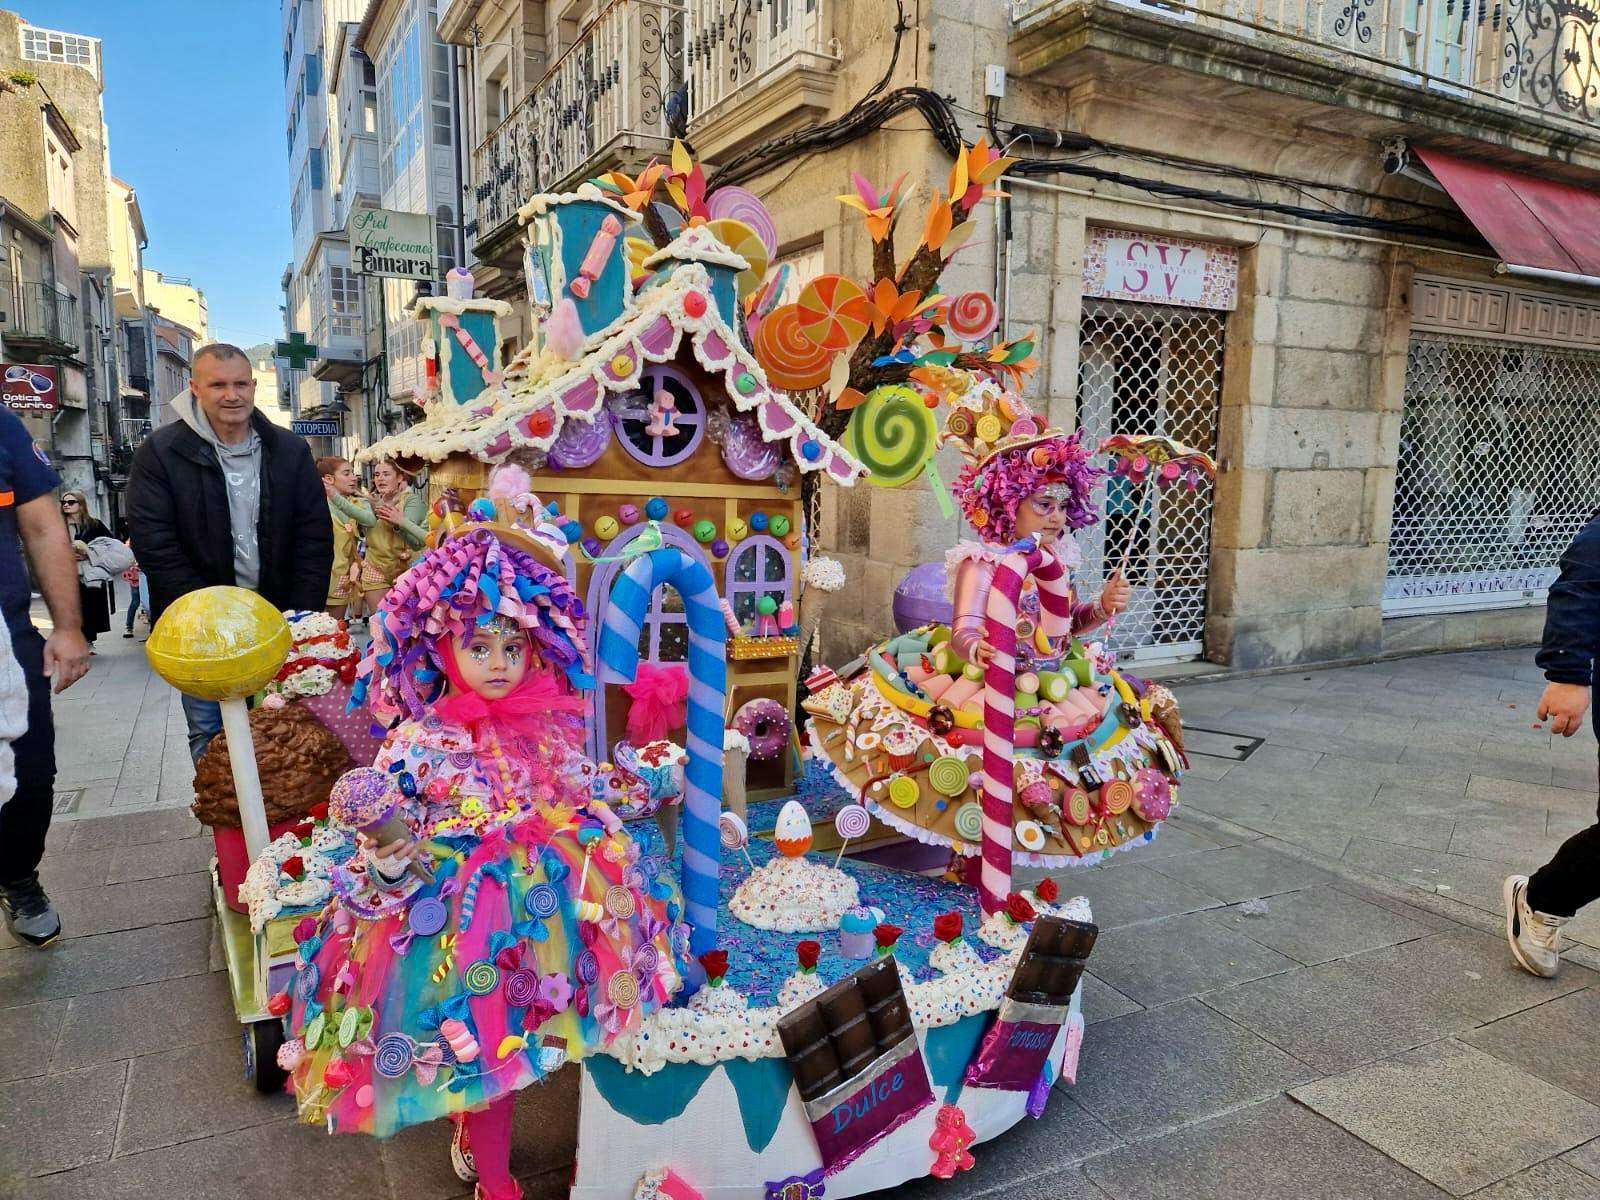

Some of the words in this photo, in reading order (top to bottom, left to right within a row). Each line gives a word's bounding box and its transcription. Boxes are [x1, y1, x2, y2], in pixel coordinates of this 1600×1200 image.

[353, 209, 388, 229] Piel
[359, 229, 432, 256] Confecciones
[355, 245, 431, 276] Tamara
[831, 1072, 905, 1134] Dulce
